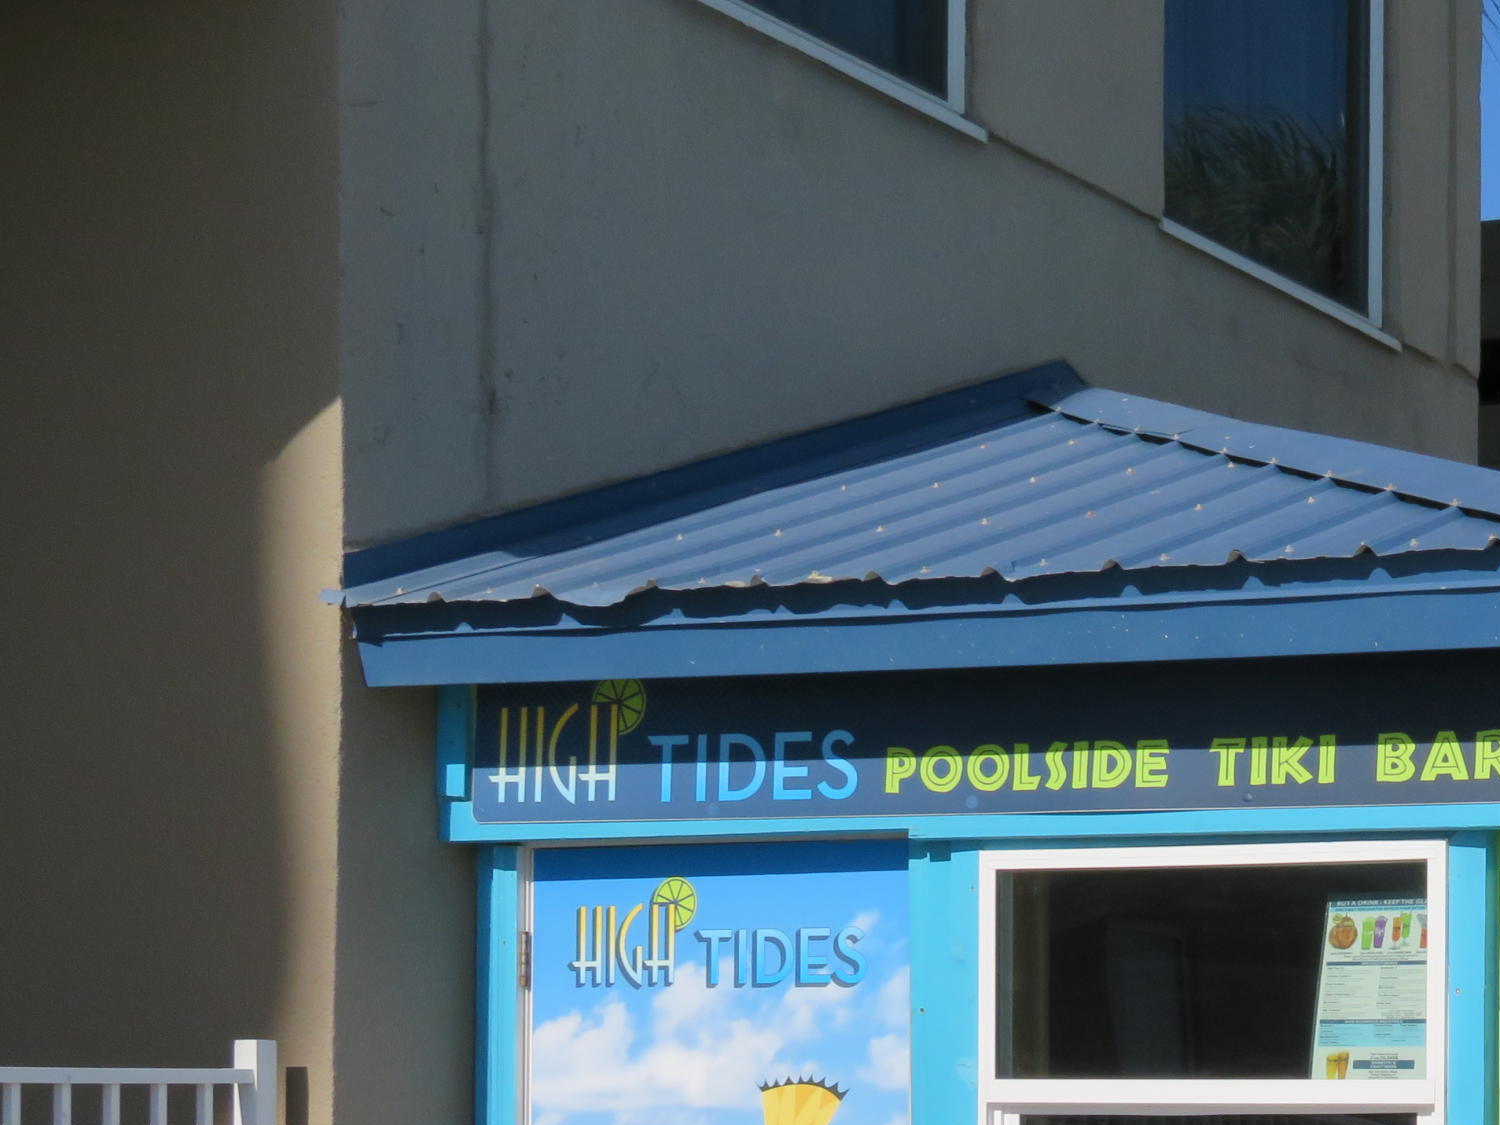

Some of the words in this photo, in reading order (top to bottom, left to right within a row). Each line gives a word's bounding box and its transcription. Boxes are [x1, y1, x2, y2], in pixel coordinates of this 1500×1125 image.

[488, 702, 619, 805] HIGH
[647, 729, 859, 803] TIDES
[884, 738, 1171, 794] POOLSIDE
[1208, 733, 1337, 788] TIKI
[569, 902, 678, 990] HIGH
[694, 925, 869, 989] TIDES
